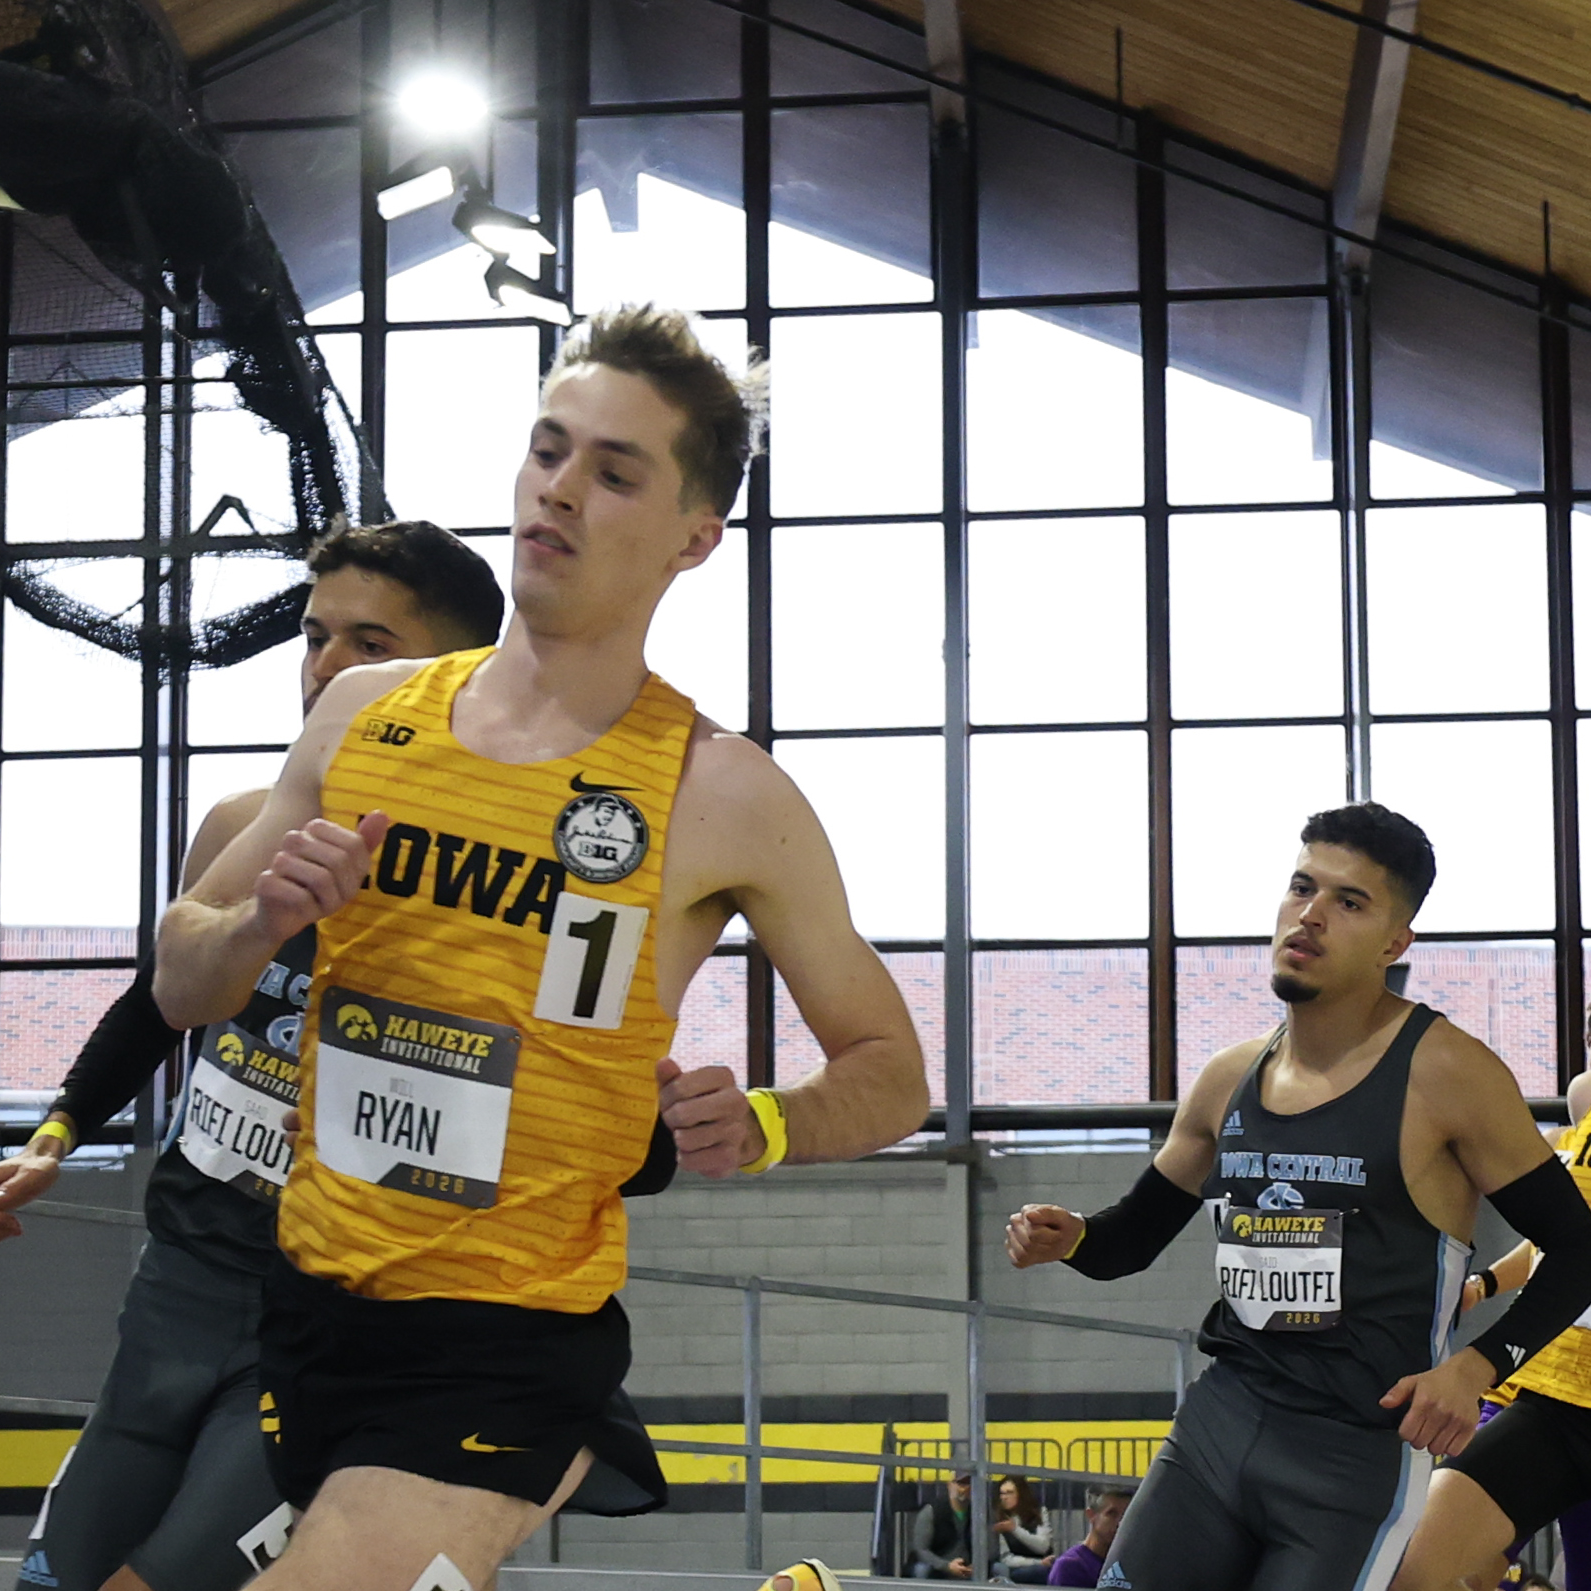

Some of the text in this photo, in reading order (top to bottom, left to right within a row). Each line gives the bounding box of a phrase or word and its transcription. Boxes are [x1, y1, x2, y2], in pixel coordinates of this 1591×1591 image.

[358, 814, 567, 935] OWA
[568, 910, 617, 1018] 1
[248, 1050, 300, 1082] HAW
[380, 1037, 480, 1074] INVITATIONAL
[242, 1066, 301, 1101] INVITATI
[190, 1087, 233, 1145] RIFI
[354, 1090, 441, 1156] RYAN
[411, 1168, 465, 1194] 2026
[1221, 1151, 1366, 1186] IOWA CENTRAL
[1252, 1232, 1319, 1244] INVITATIONAL
[1220, 1266, 1336, 1302] RIFI LOUTFI
[1286, 1313, 1321, 1324] 2026
